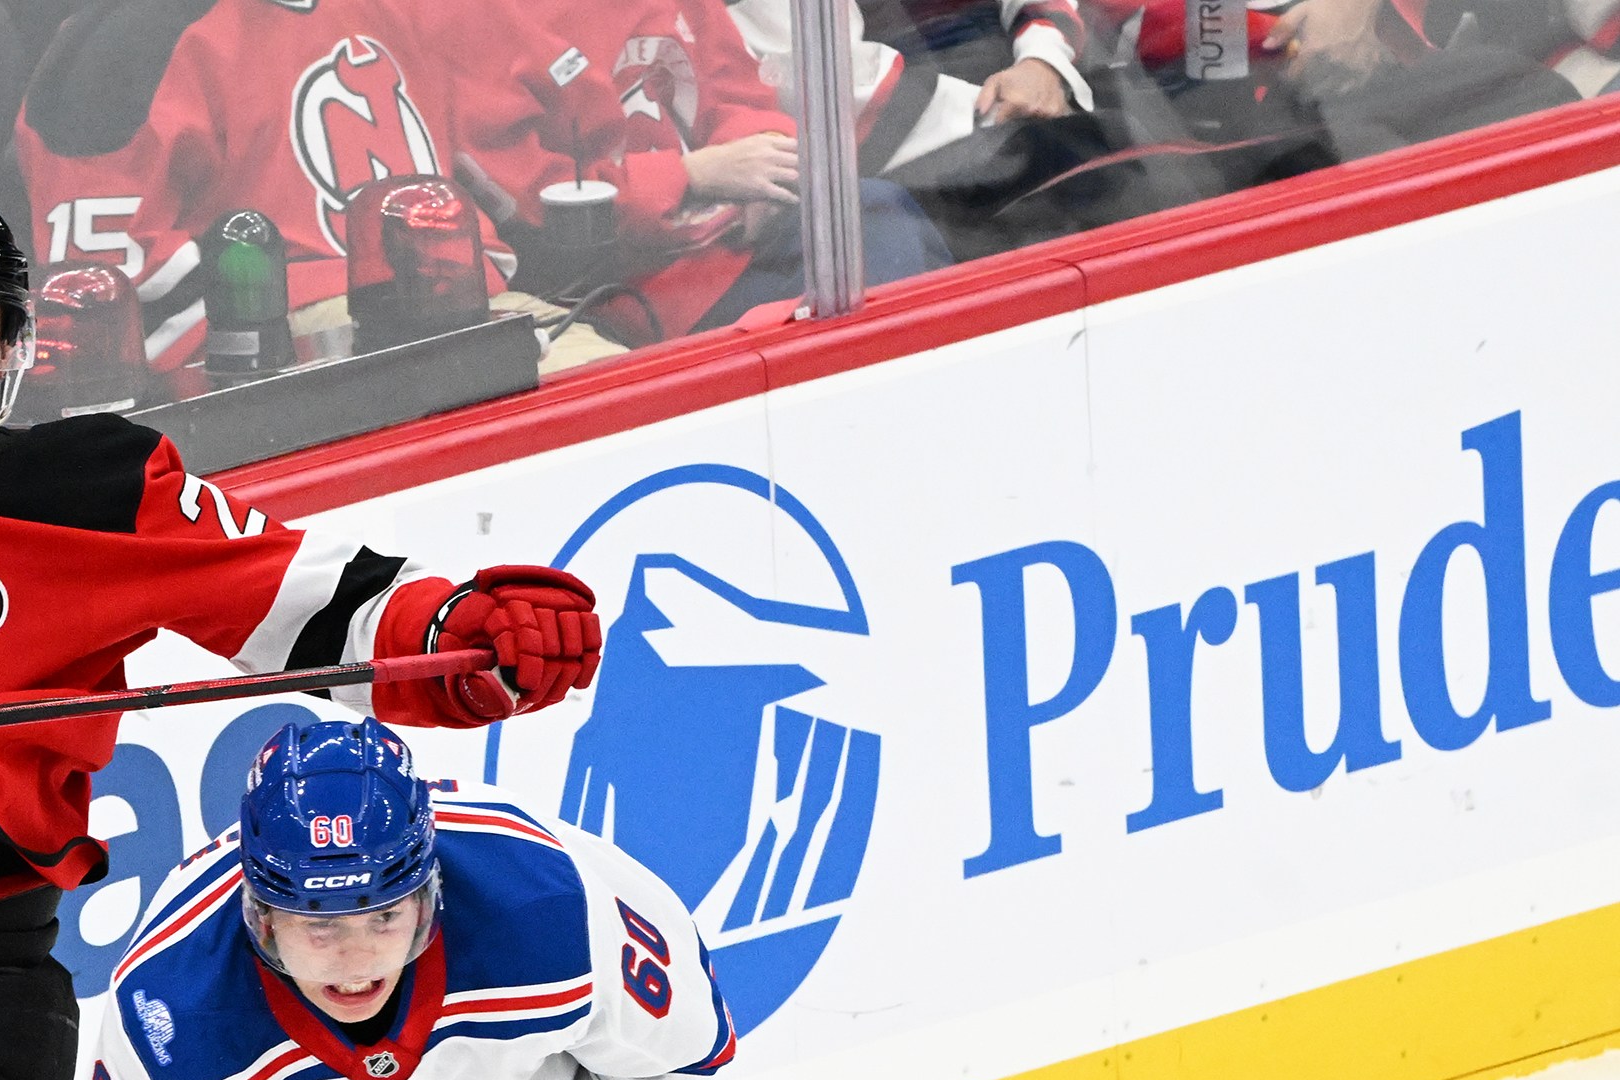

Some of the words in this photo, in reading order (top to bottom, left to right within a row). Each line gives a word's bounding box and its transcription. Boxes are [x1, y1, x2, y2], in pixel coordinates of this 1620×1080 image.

[47, 196, 144, 279] 15
[310, 814, 354, 848] 60
[304, 872, 372, 889] CCM
[614, 896, 673, 1019] 60
